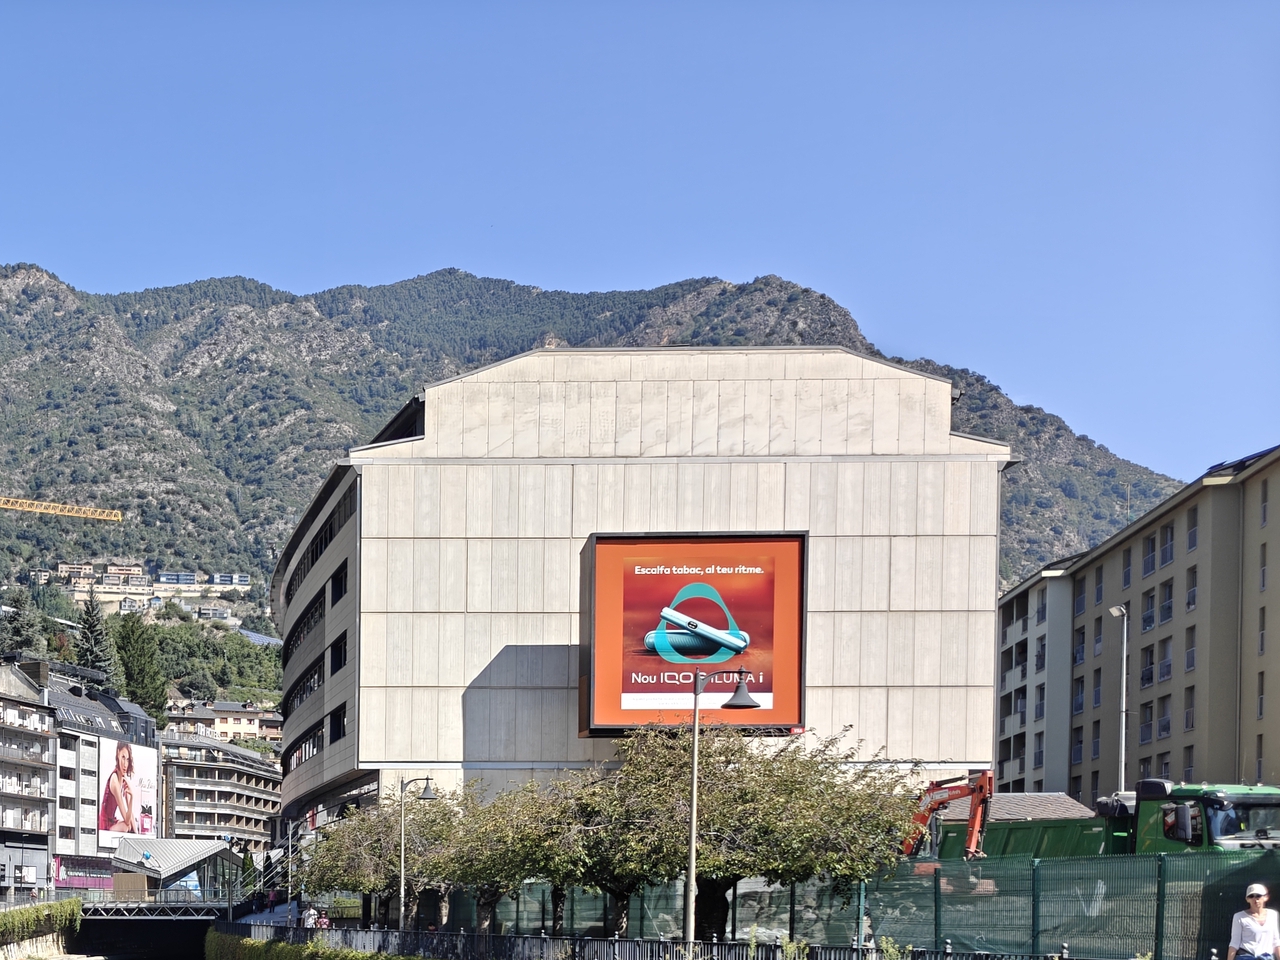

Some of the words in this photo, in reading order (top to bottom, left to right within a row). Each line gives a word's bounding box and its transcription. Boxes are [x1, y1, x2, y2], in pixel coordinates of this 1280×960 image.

[634, 565, 671, 575] Escalfa
[672, 566, 704, 576] tabac,
[705, 565, 715, 574] al
[716, 565, 734, 574] teu
[631, 672, 657, 684] Nou
